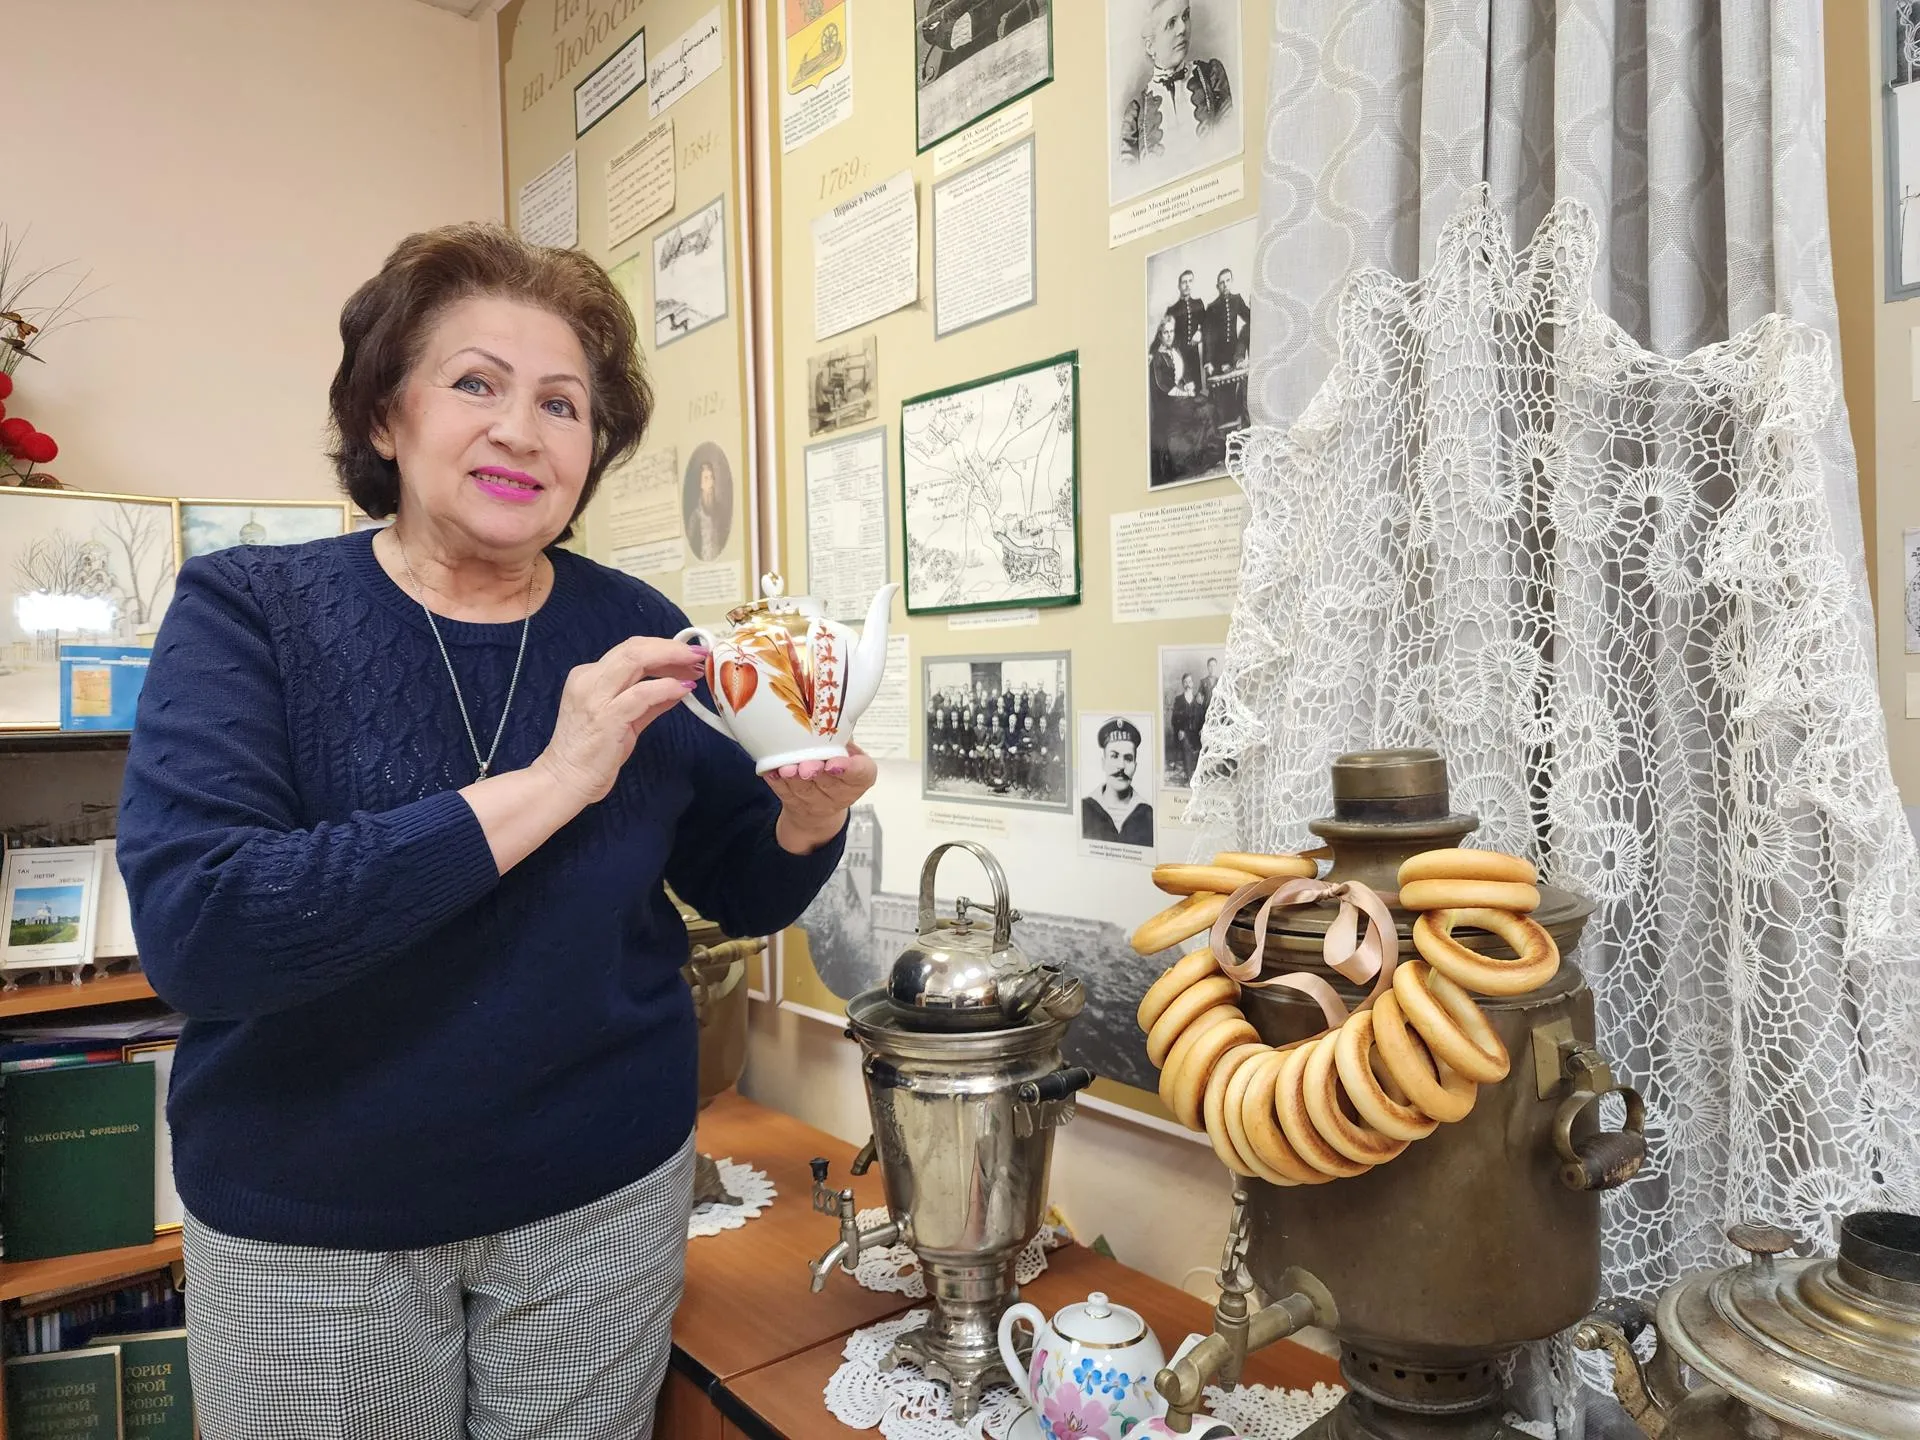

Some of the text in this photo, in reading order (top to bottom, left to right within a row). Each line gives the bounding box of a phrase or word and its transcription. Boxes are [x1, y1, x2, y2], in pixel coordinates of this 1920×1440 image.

[820, 156, 860, 199] 1769
[864, 183, 887, 202] России
[24, 1123, 140, 1144] НАУКОГРАД ФРЯЗИНО
